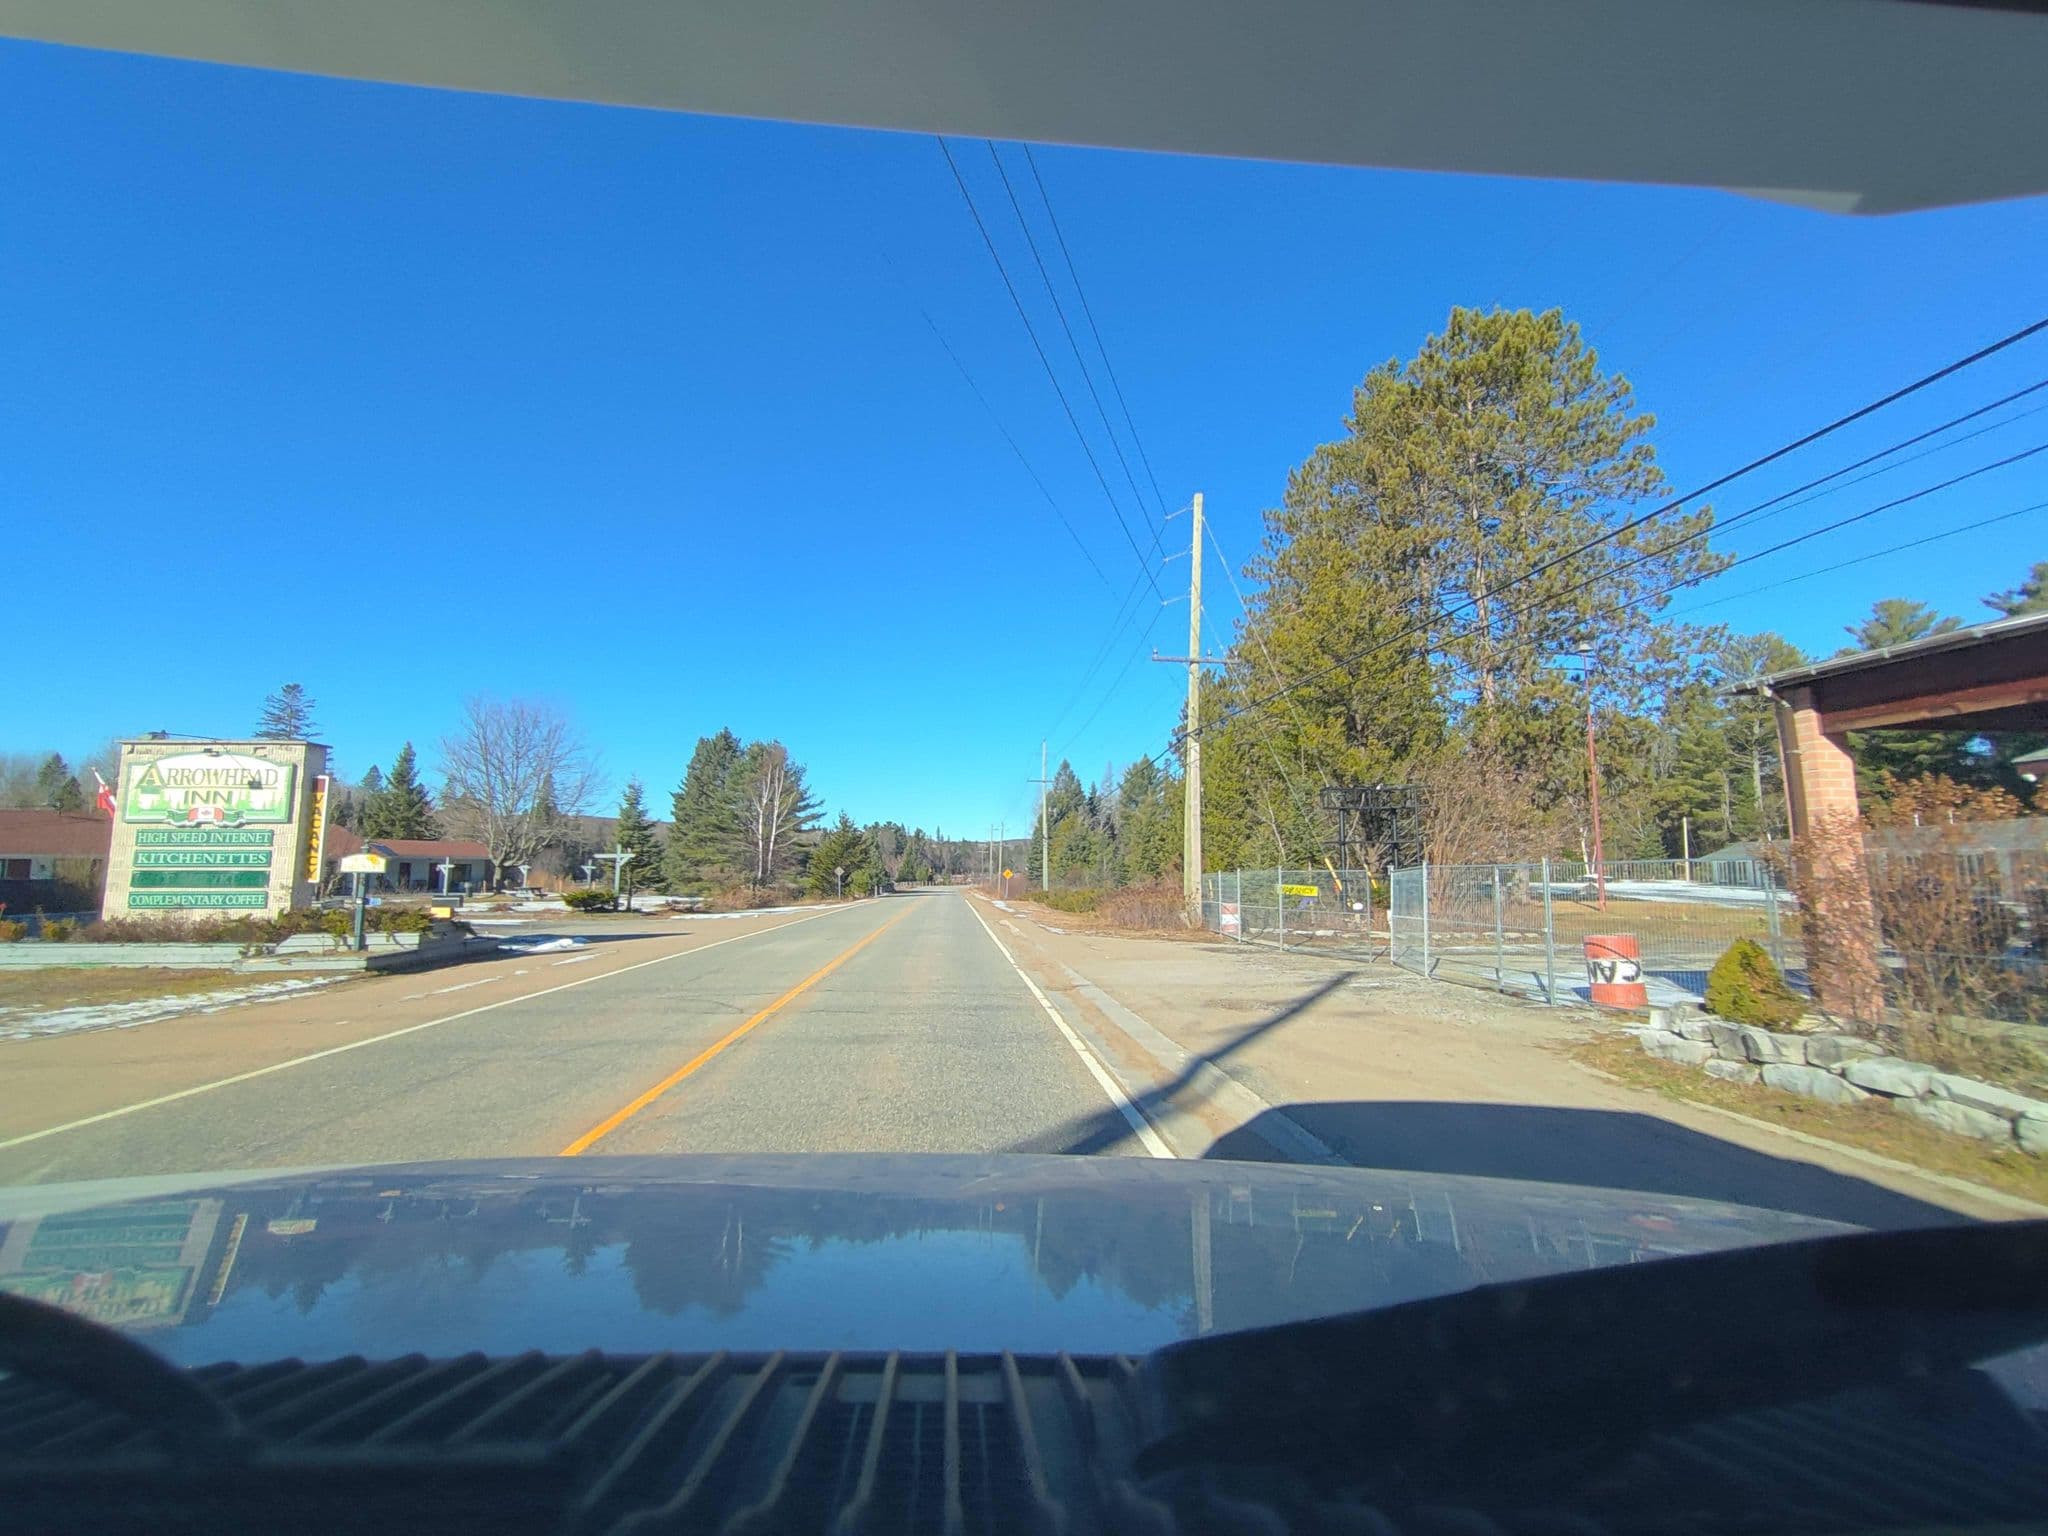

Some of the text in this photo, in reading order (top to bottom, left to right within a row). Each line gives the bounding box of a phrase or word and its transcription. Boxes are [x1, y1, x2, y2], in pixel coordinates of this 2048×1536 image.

[134, 761, 279, 788] ARROWHEAD
[184, 790, 233, 805] INN
[137, 832, 271, 843] HIGH SPEED INTERNET
[137, 852, 267, 864] KITCHENETTES
[226, 894, 265, 905] COFFEE
